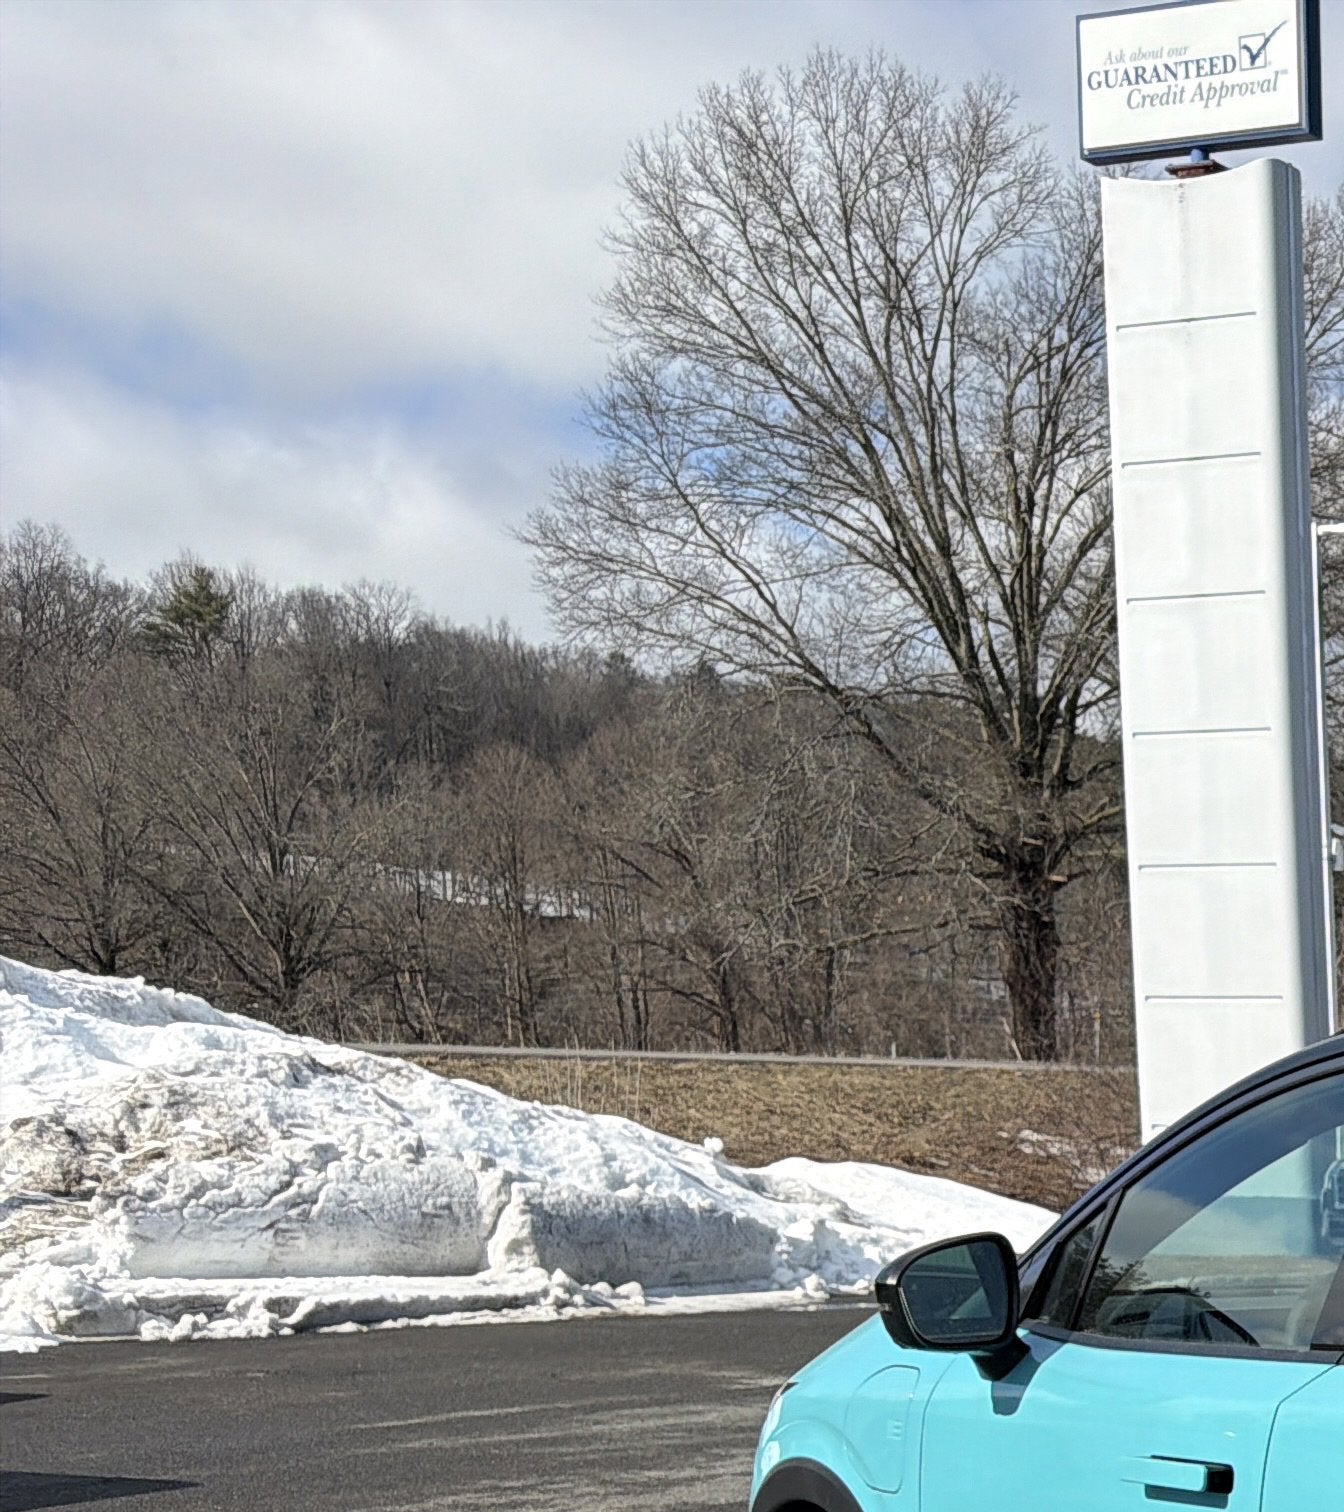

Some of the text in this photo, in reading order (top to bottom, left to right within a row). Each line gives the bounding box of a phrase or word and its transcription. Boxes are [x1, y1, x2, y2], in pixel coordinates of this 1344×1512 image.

[1087, 54, 1238, 91] GUARANTEED
[1103, 44, 1190, 66] Ask about our
[1126, 70, 1280, 110] Credit Approval
